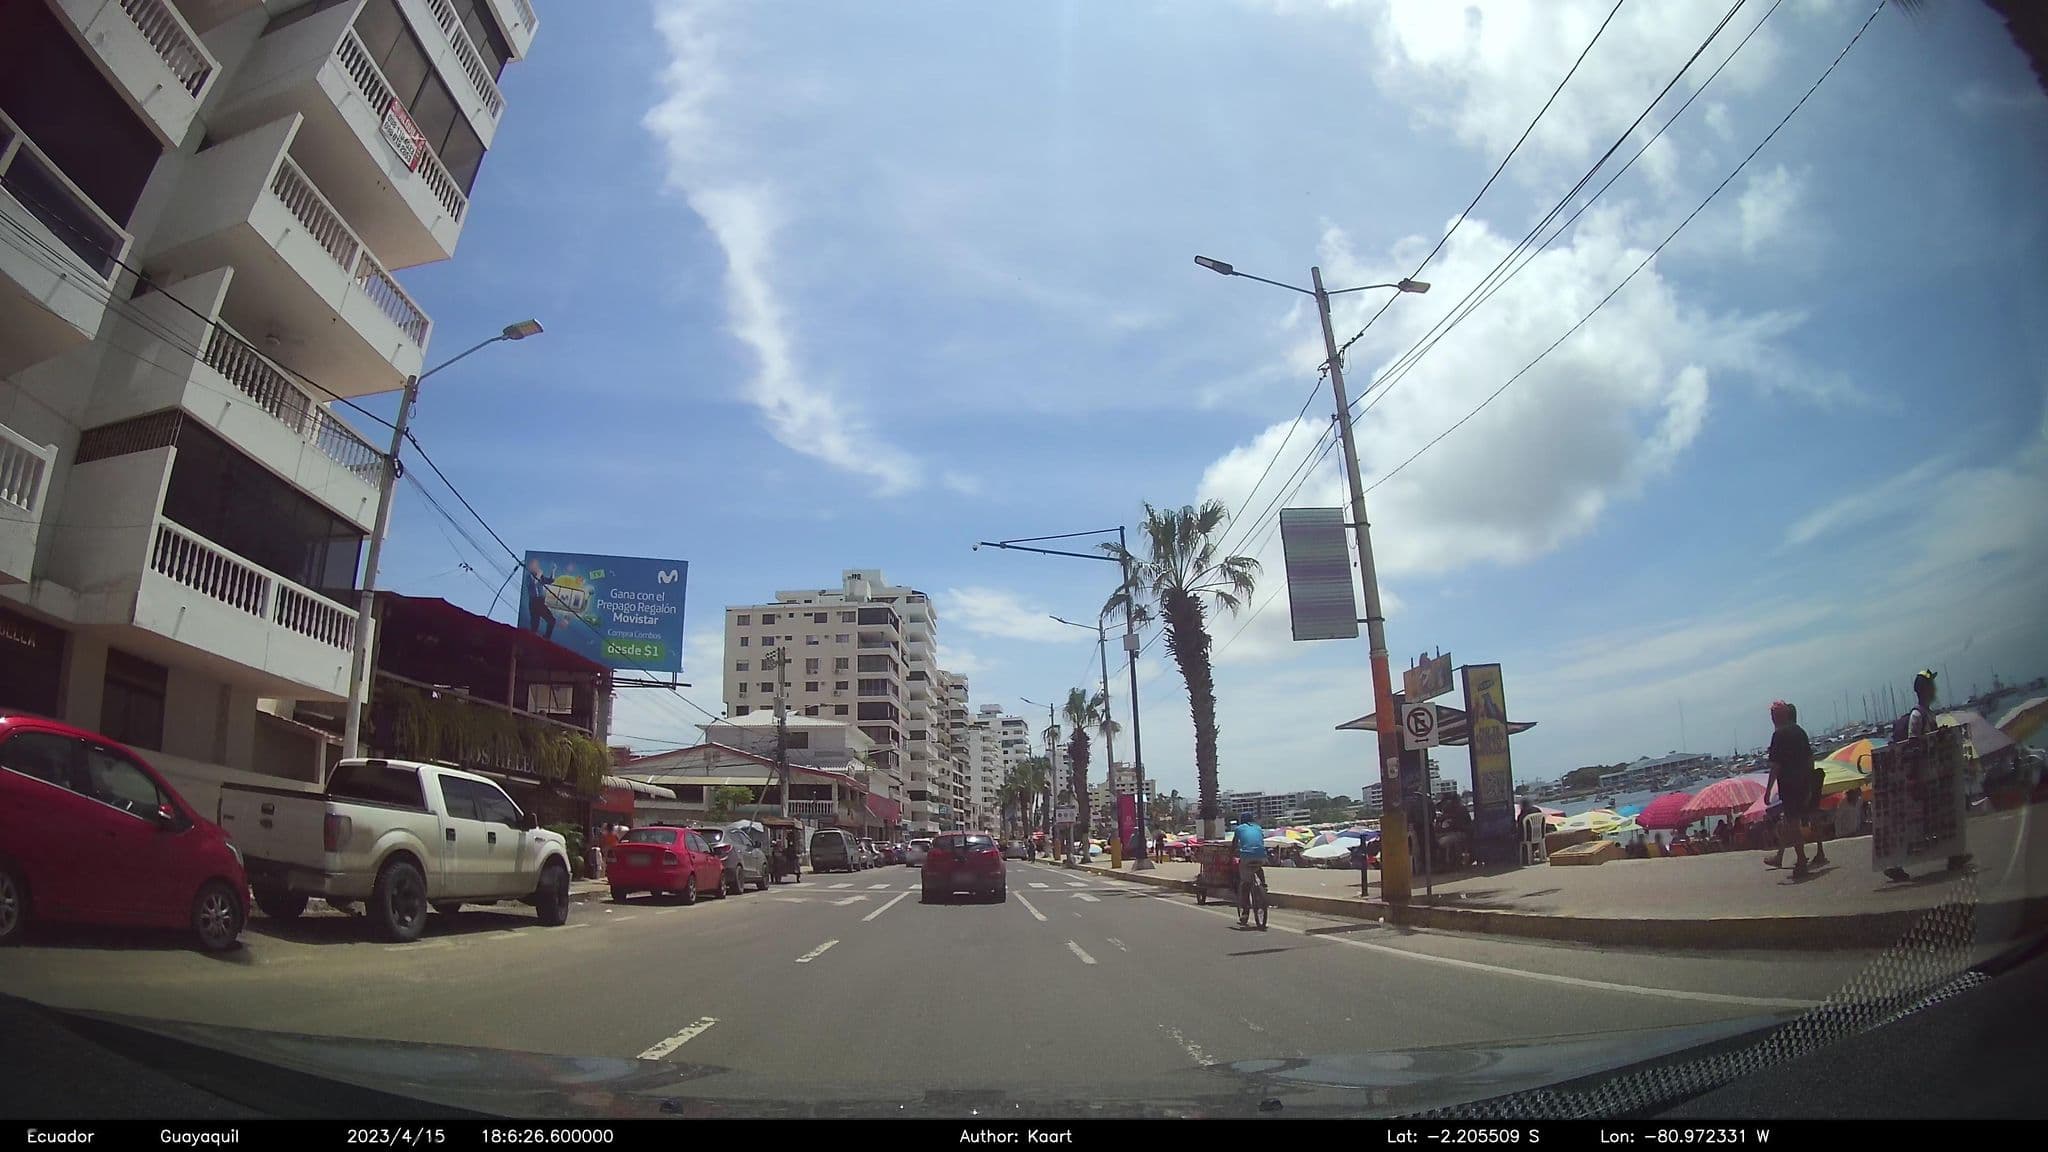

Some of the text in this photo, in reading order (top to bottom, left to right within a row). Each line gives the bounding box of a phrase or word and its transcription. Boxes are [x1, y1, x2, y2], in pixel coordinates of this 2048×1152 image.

[610, 588, 665, 602] Gana con el
[597, 599, 676, 615] Prepago Regalón
[613, 612, 659, 625] Movistar
[607, 628, 634, 639] Compra
[607, 642, 659, 658] desde $1
